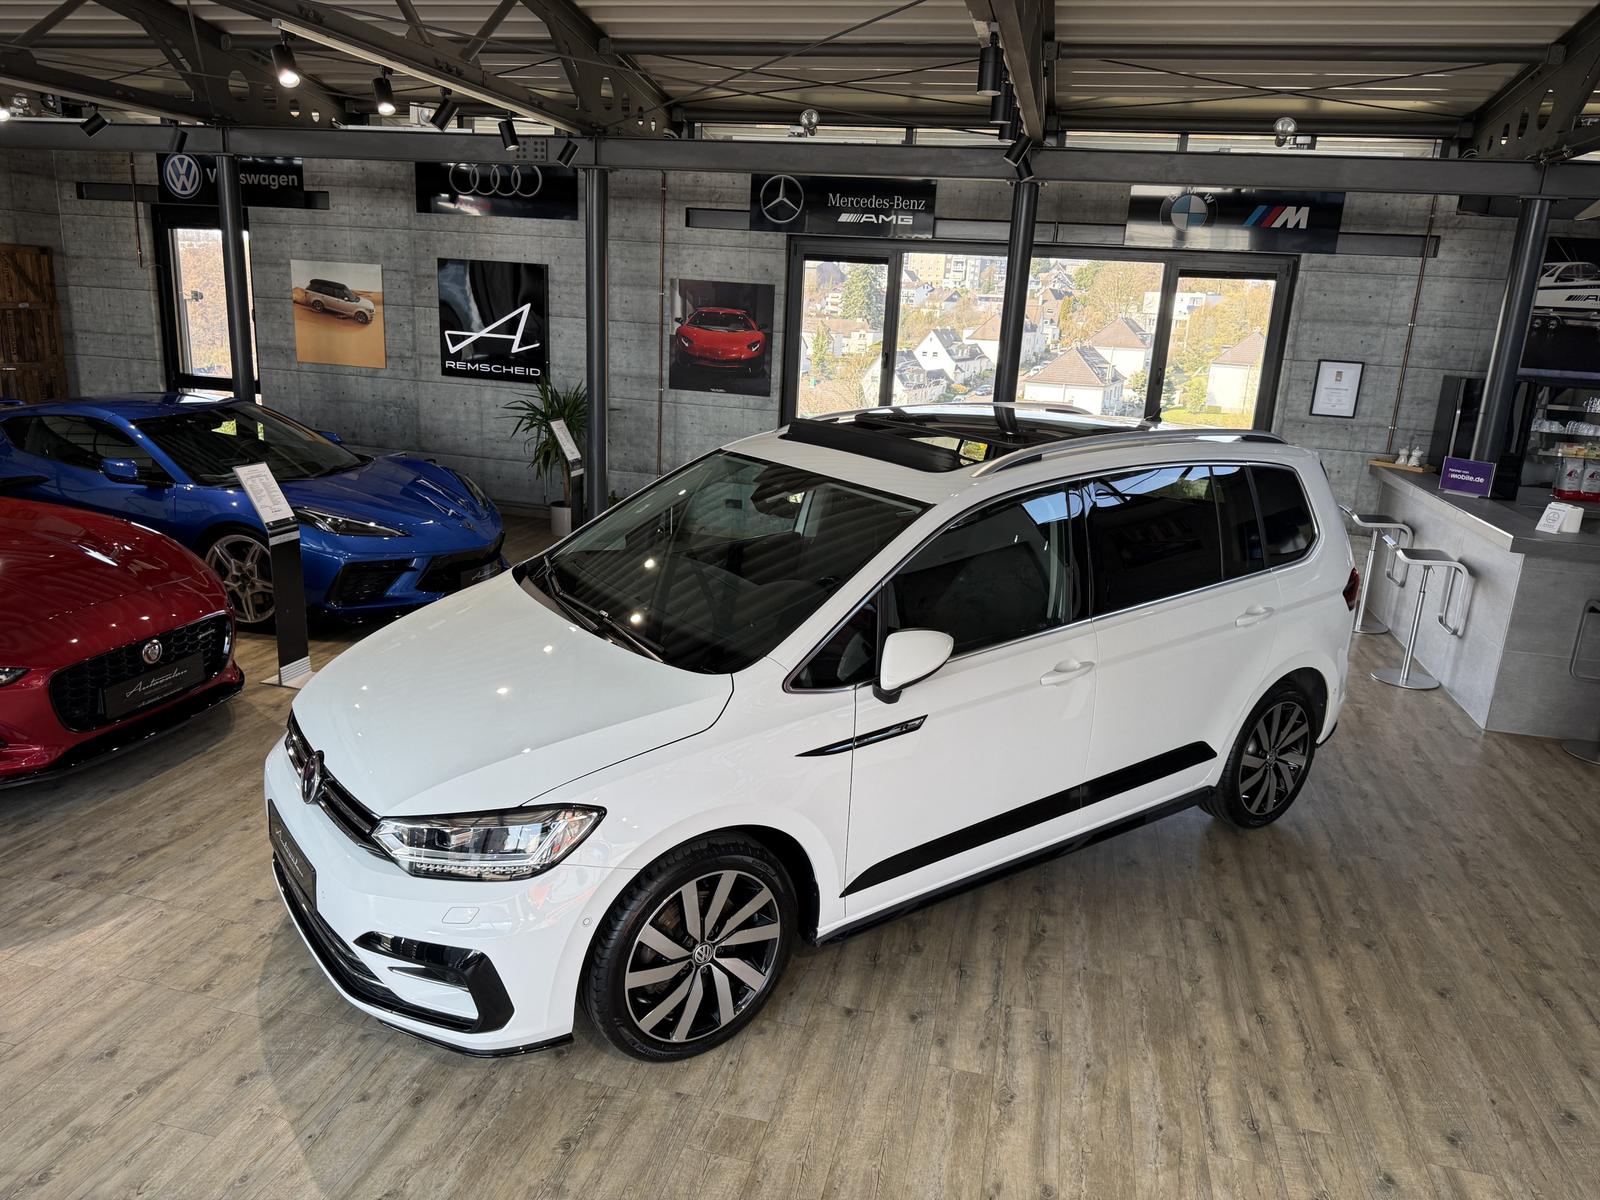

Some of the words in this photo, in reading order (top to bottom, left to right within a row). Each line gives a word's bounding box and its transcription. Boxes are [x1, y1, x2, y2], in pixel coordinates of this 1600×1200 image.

[206, 167, 298, 190] Vswagen
[828, 193, 926, 211] Mercedes-Benz
[445, 360, 541, 377] REMSCHEID
[1449, 473, 1485, 484] mobile.de
